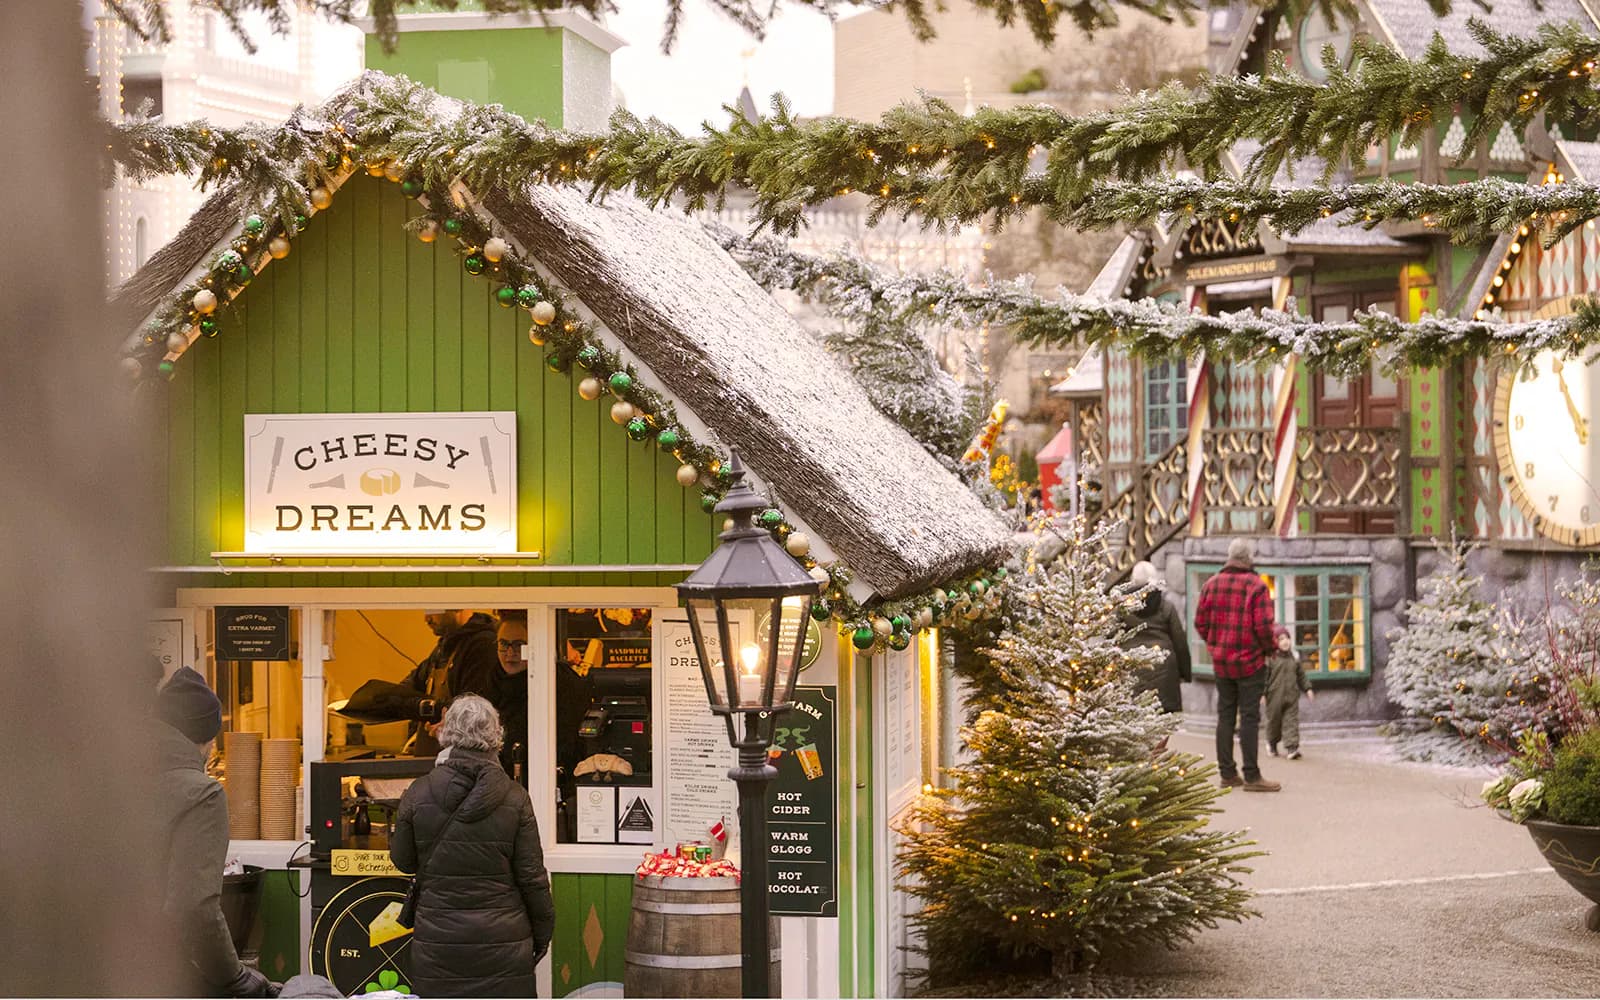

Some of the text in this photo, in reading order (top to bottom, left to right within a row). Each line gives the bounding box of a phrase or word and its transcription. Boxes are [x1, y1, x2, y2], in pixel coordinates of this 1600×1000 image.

[1514, 415, 1524, 431] 9
[294, 433, 469, 471] CHEESY
[1525, 463, 1535, 479] 8
[1549, 496, 1559, 512] 7
[275, 504, 486, 531] DREAMS
[1580, 506, 1590, 522] 6
[674, 636, 721, 648] CHES
[670, 656, 724, 667] DREM
[777, 792, 802, 801] HOT
[772, 805, 810, 814] CIDER
[771, 832, 809, 841] WARM
[357, 862, 398, 874] @cheesydr
[777, 871, 803, 880] HOT
[768, 884, 820, 894] OCOLAT
[340, 948, 361, 958] EST.
